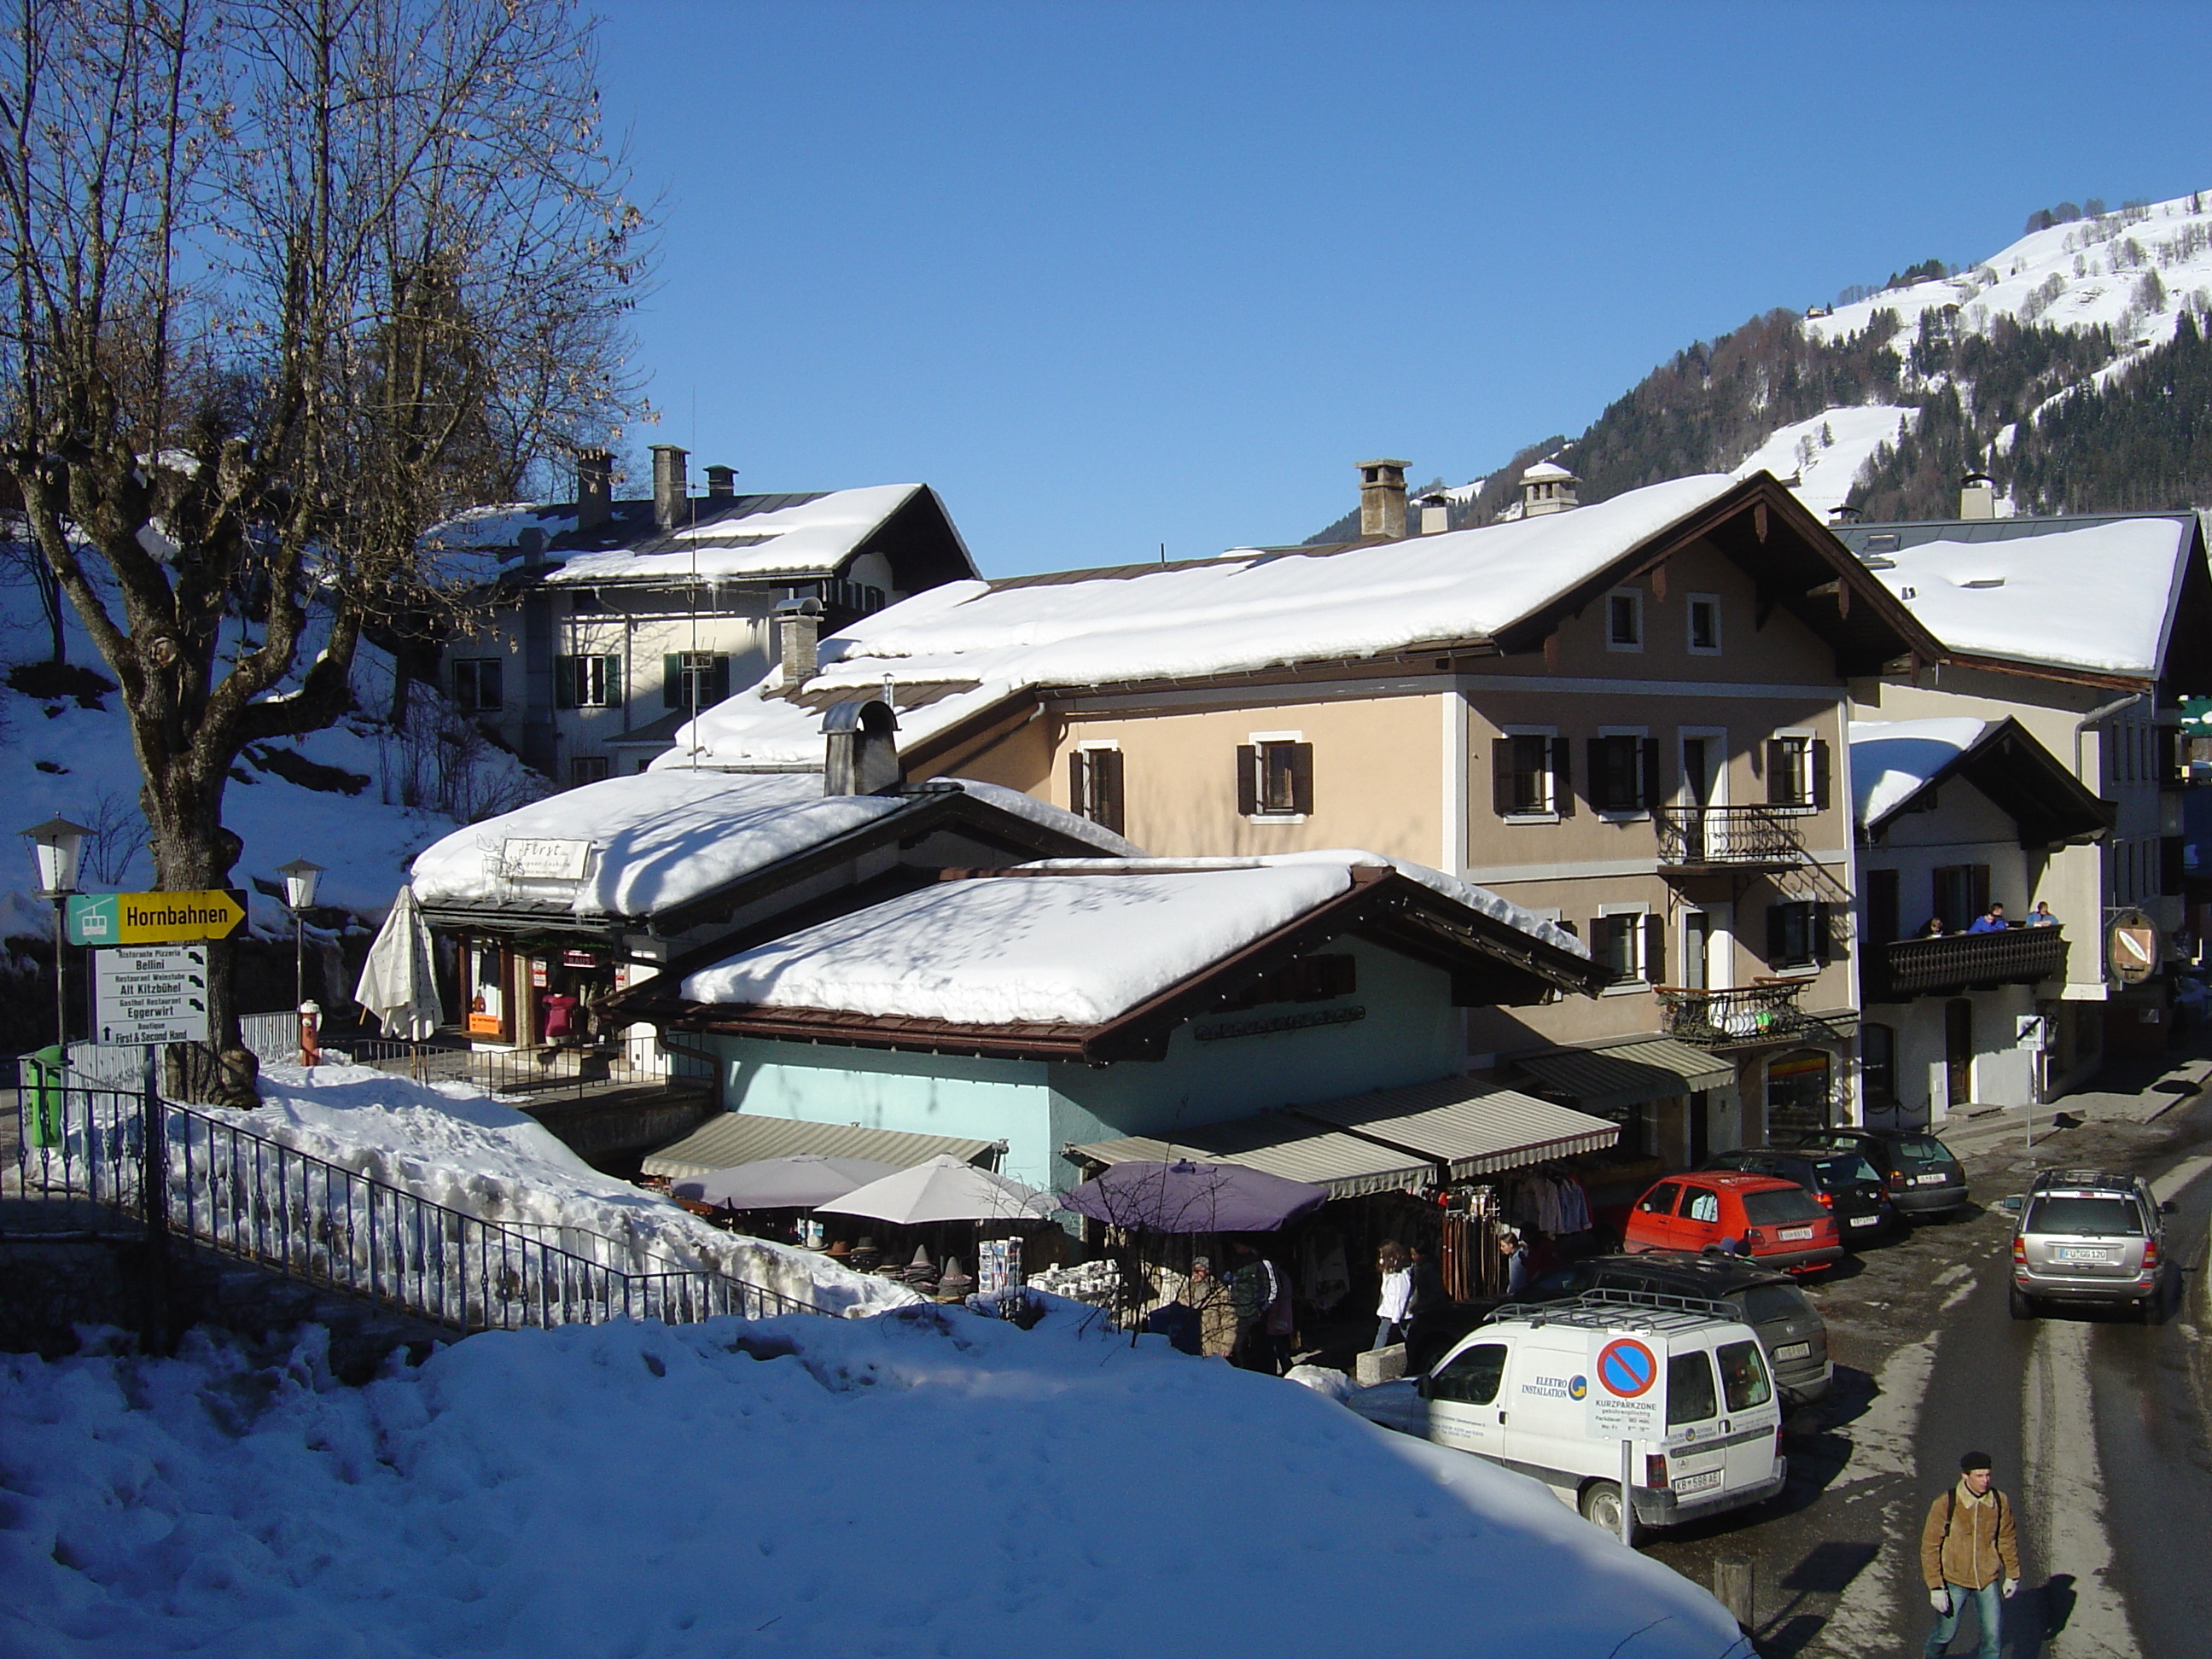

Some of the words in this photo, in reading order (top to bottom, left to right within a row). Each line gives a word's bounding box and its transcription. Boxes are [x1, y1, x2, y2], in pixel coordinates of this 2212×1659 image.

[523, 840, 561, 857] First
[127, 905, 228, 927] Hornbahnen
[119, 950, 153, 958] Ristorante
[136, 958, 165, 970] Bellini
[120, 984, 134, 995] Alt
[137, 982, 181, 994] Kitzbühel
[146, 997, 181, 1005] Restaurant
[127, 1005, 174, 1019] Eggerwirt
[115, 1033, 132, 1044] First
[133, 1032, 140, 1042] &
[141, 1030, 167, 1042] Second
[169, 1029, 187, 1040] Hand
[2092, 1250, 2106, 1259] 120
[1535, 1376, 1568, 1388] ELEKTRO
[1522, 1384, 1568, 1398] INSTALLATION
[1595, 1400, 1657, 1411] KURZPARKZONE
[1677, 1479, 1687, 1492] KB
[1708, 1471, 1718, 1484] AE
